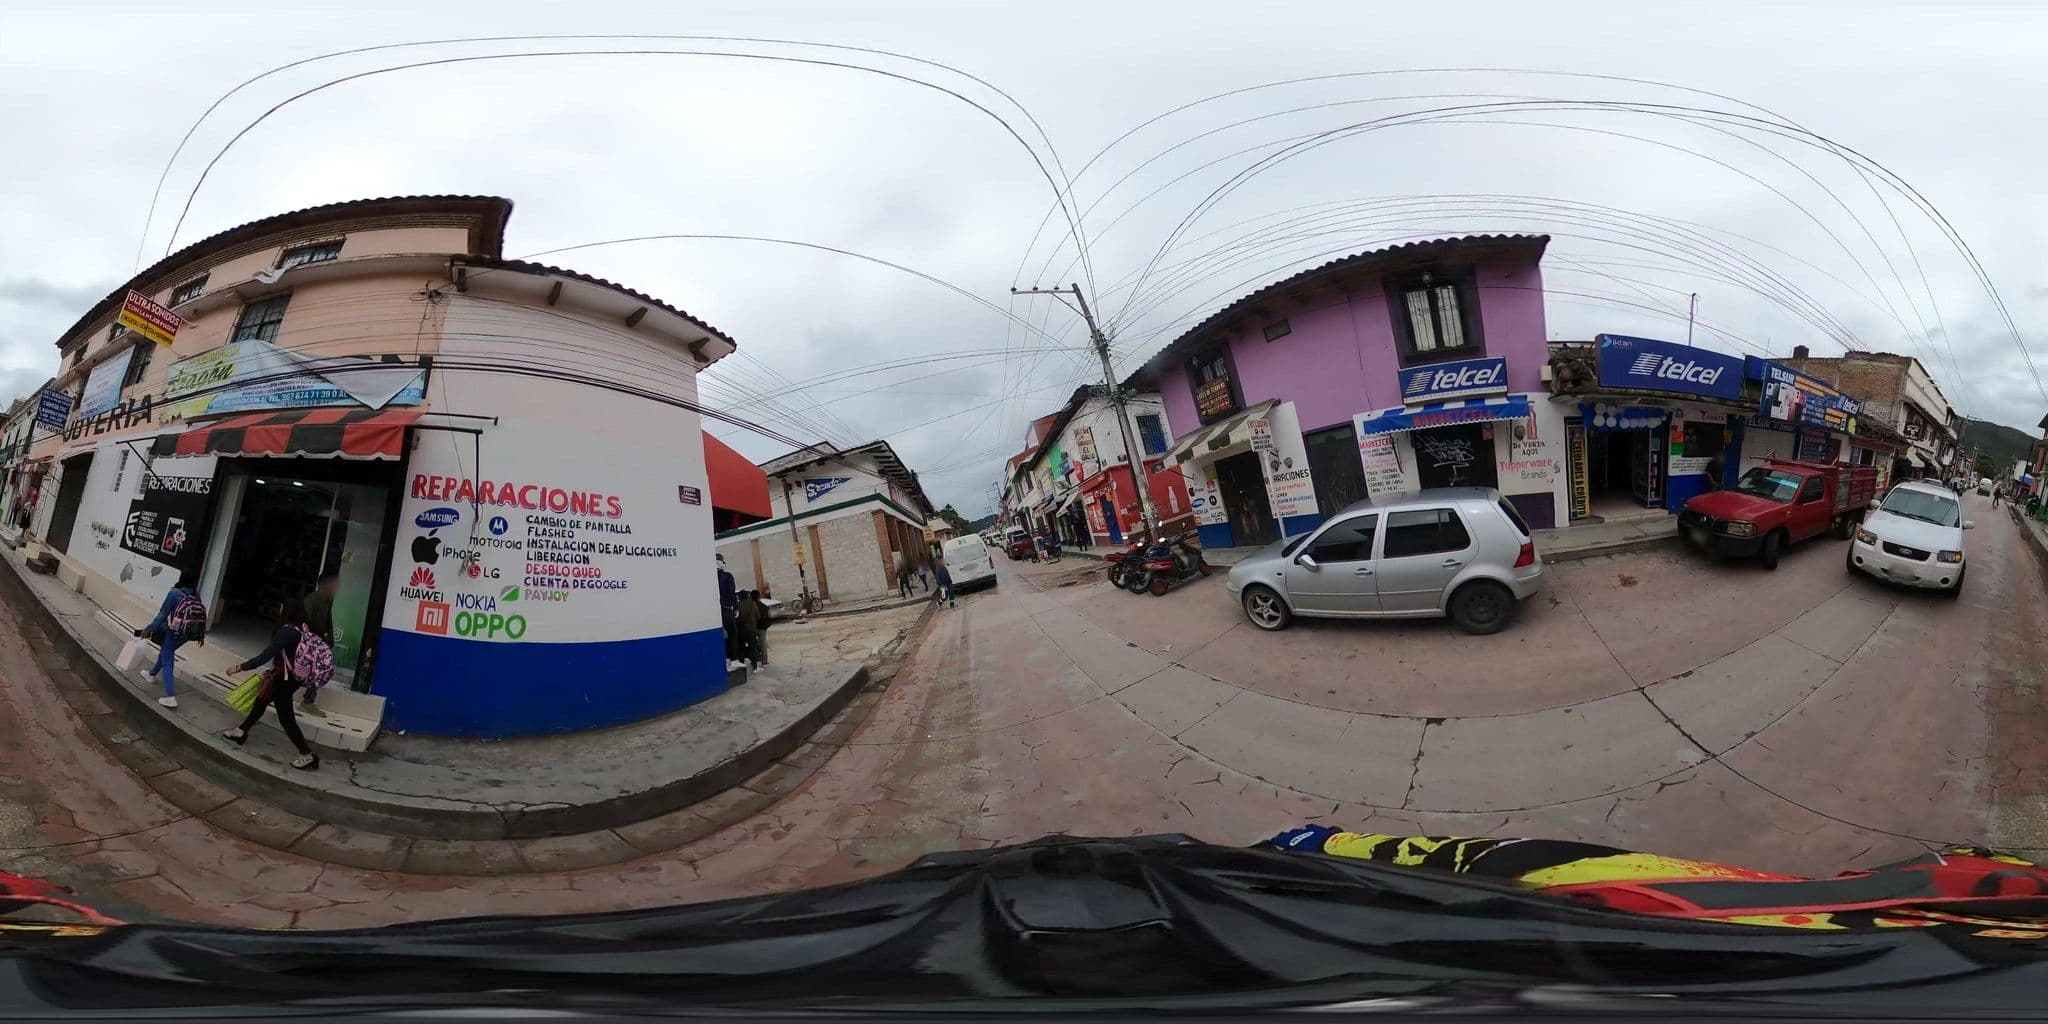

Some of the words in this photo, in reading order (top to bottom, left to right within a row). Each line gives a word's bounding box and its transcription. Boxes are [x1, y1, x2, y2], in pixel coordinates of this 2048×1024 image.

[130, 292, 179, 327] ULTRASONIDOS
[1431, 363, 1503, 391] telcel
[1657, 356, 1724, 385] telcel
[1771, 367, 1795, 385] TELSUR
[1500, 459, 1553, 472] Tupperware
[1520, 470, 1548, 480] Brands
[411, 474, 622, 519] REPARACIONES
[419, 512, 458, 523] SAMSUNG
[526, 515, 567, 528] CAMBIO
[570, 519, 582, 529] DE
[585, 521, 632, 535] PANTALLA
[527, 526, 575, 539] FLASHEO
[469, 535, 522, 550] motorola
[526, 538, 596, 553] INSTALACION
[526, 551, 590, 565] LIBERACION
[483, 567, 500, 579] LG
[524, 577, 569, 589] CUENTA
[400, 587, 444, 603] HUAWEI
[455, 593, 496, 612] NOKIA
[524, 588, 569, 602] PAYJOY
[455, 611, 527, 640] OPPO
